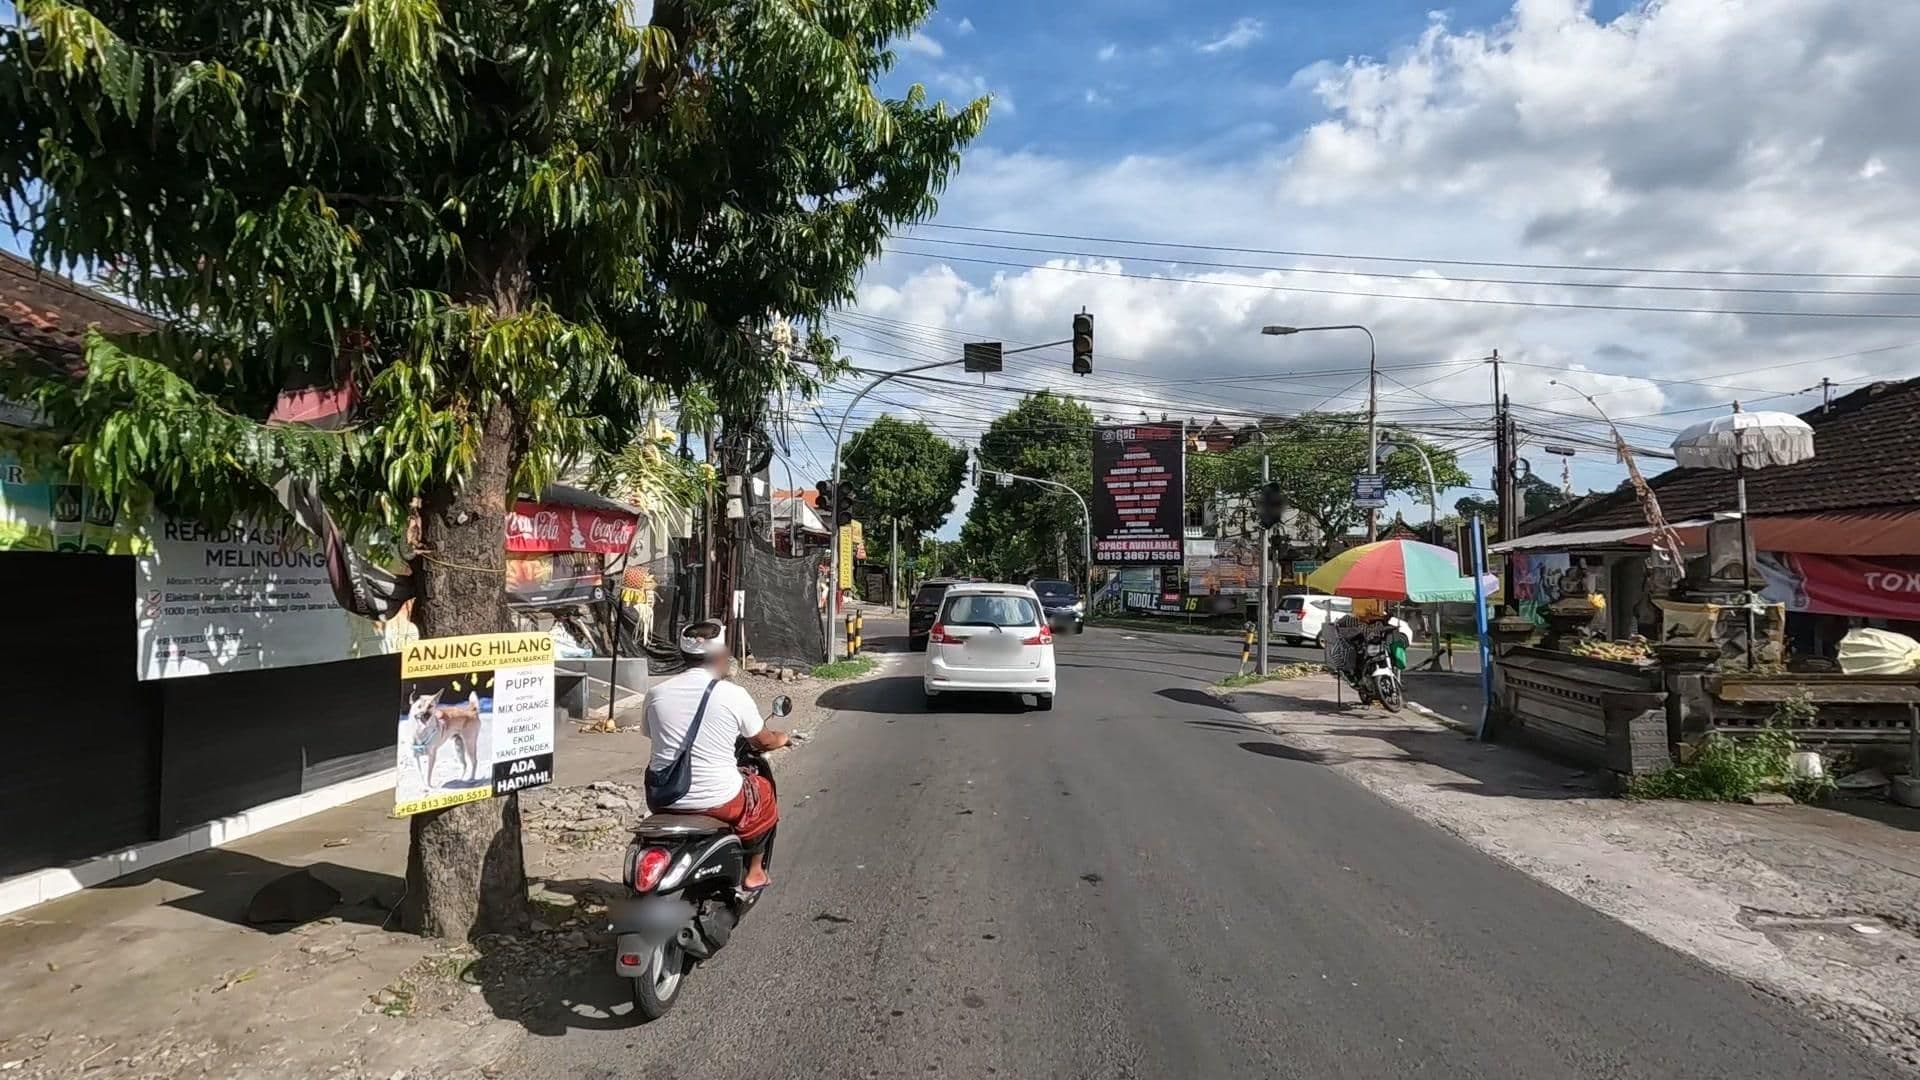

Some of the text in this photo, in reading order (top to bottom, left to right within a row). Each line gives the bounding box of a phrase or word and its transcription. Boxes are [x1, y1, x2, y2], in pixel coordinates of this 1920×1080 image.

[1099, 541, 1178, 551] SPACE AVAILABLE
[1097, 552, 1122, 560] 0813
[1127, 592, 1160, 609] RIDDLE
[1185, 597, 1198, 610] 16
[408, 637, 551, 662] ANJING HILANG
[407, 664, 443, 673] DAERAH
[471, 659, 497, 668] DEKAT
[499, 656, 522, 665] SAYAN
[523, 655, 550, 663] MARKET
[505, 676, 544, 690] PUPPY
[498, 699, 549, 713] MIX ORANGE
[507, 722, 541, 734] MEMILIKI
[512, 734, 535, 745] EKOR
[496, 743, 549, 758] YANG PENDEK
[509, 759, 536, 775] ADA
[401, 789, 488, 814] +62 813 3900 5513
